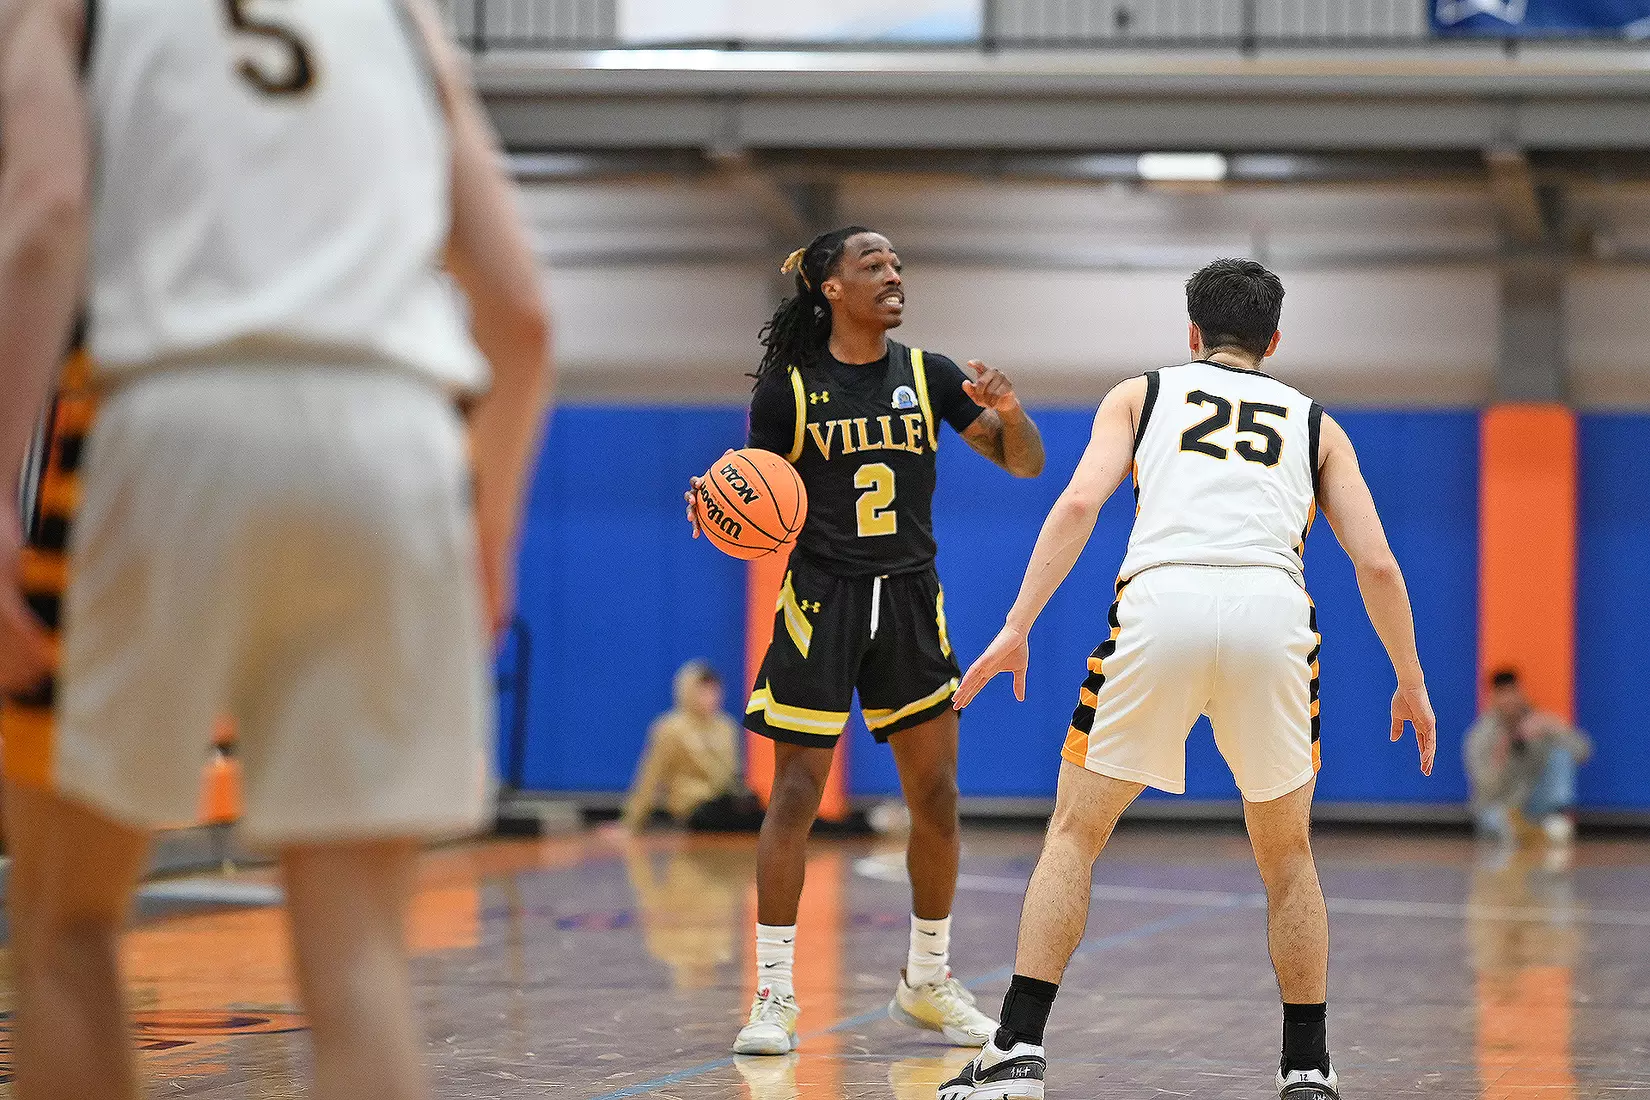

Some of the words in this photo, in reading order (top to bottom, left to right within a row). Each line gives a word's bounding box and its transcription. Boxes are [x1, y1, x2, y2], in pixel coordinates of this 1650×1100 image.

[222, 0, 318, 96] 5
[807, 413, 923, 460] VILLE
[1179, 389, 1289, 468] 25
[700, 480, 743, 540] Wilson
[720, 463, 759, 505] NCAA
[854, 463, 897, 537] 2
